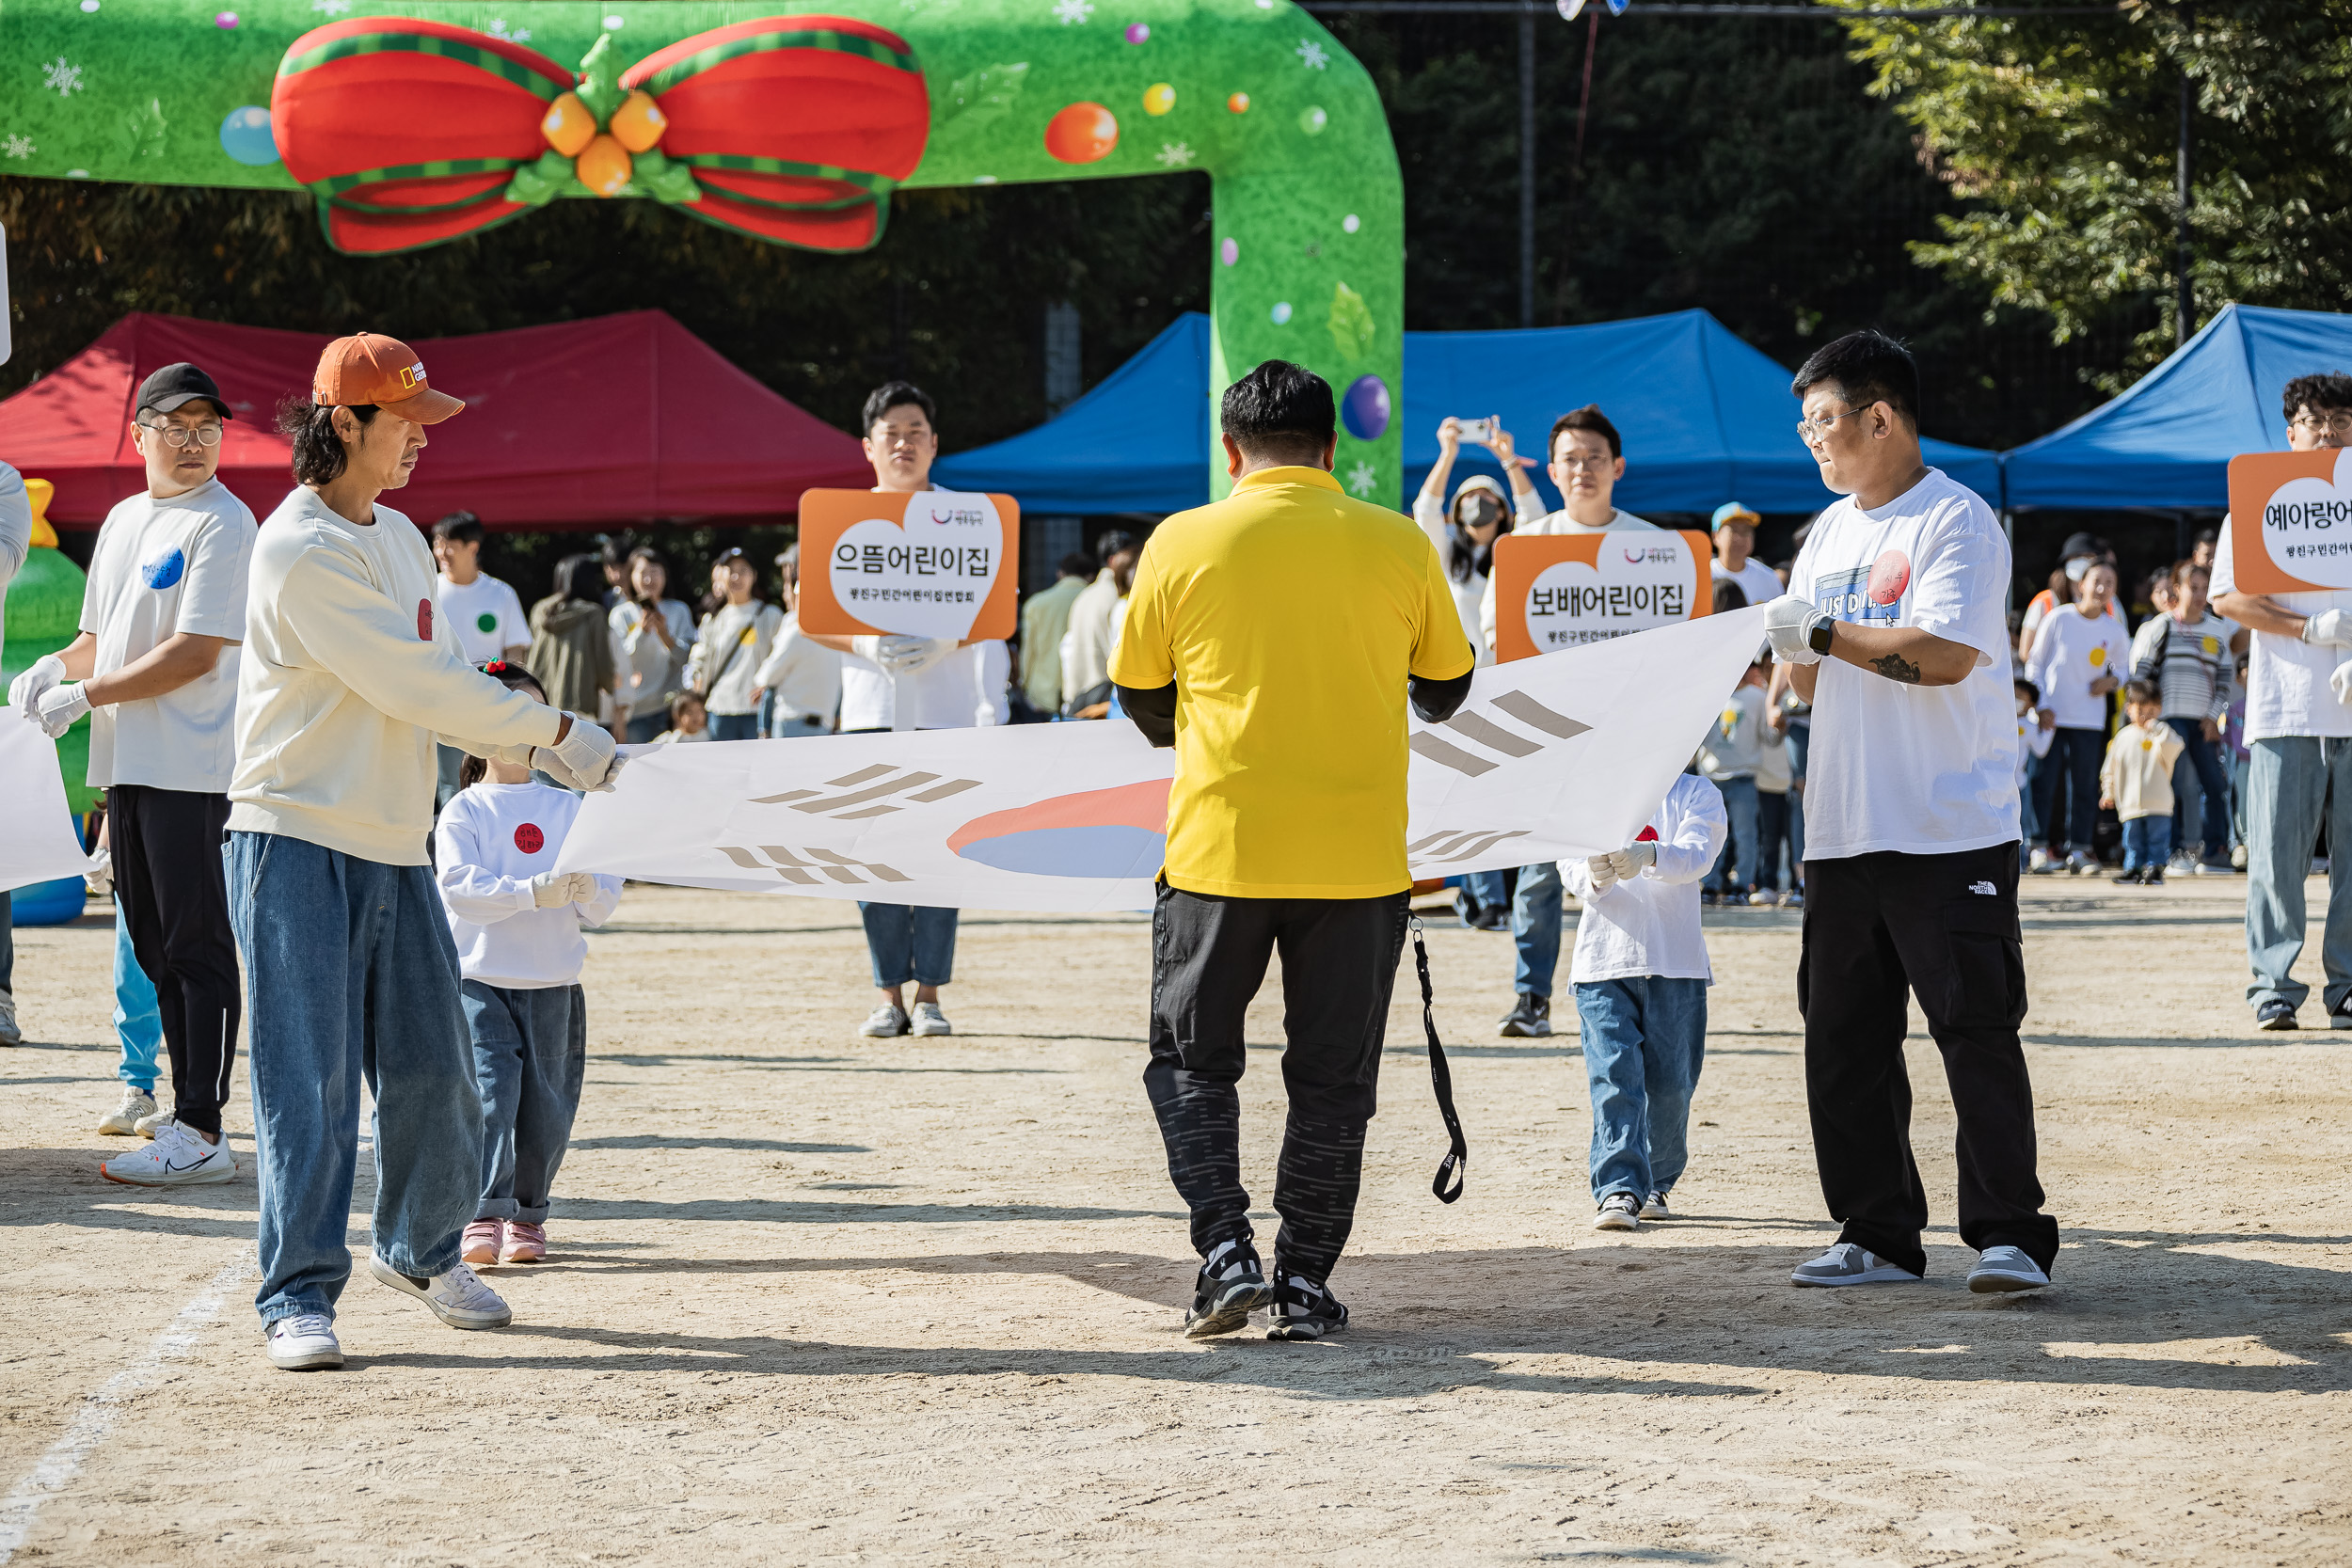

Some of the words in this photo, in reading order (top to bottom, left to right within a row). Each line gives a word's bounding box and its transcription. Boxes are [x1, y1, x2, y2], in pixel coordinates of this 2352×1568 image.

[834, 544, 990, 577] 으뜸어린이집
[850, 587, 975, 603] 광진구민간어린이집연합회
[1531, 584, 1684, 617] 보배어린이집
[1881, 588, 1897, 599] 가족
[1820, 594, 1846, 617] JUST
[1443, 1153, 1455, 1170] NIKE
